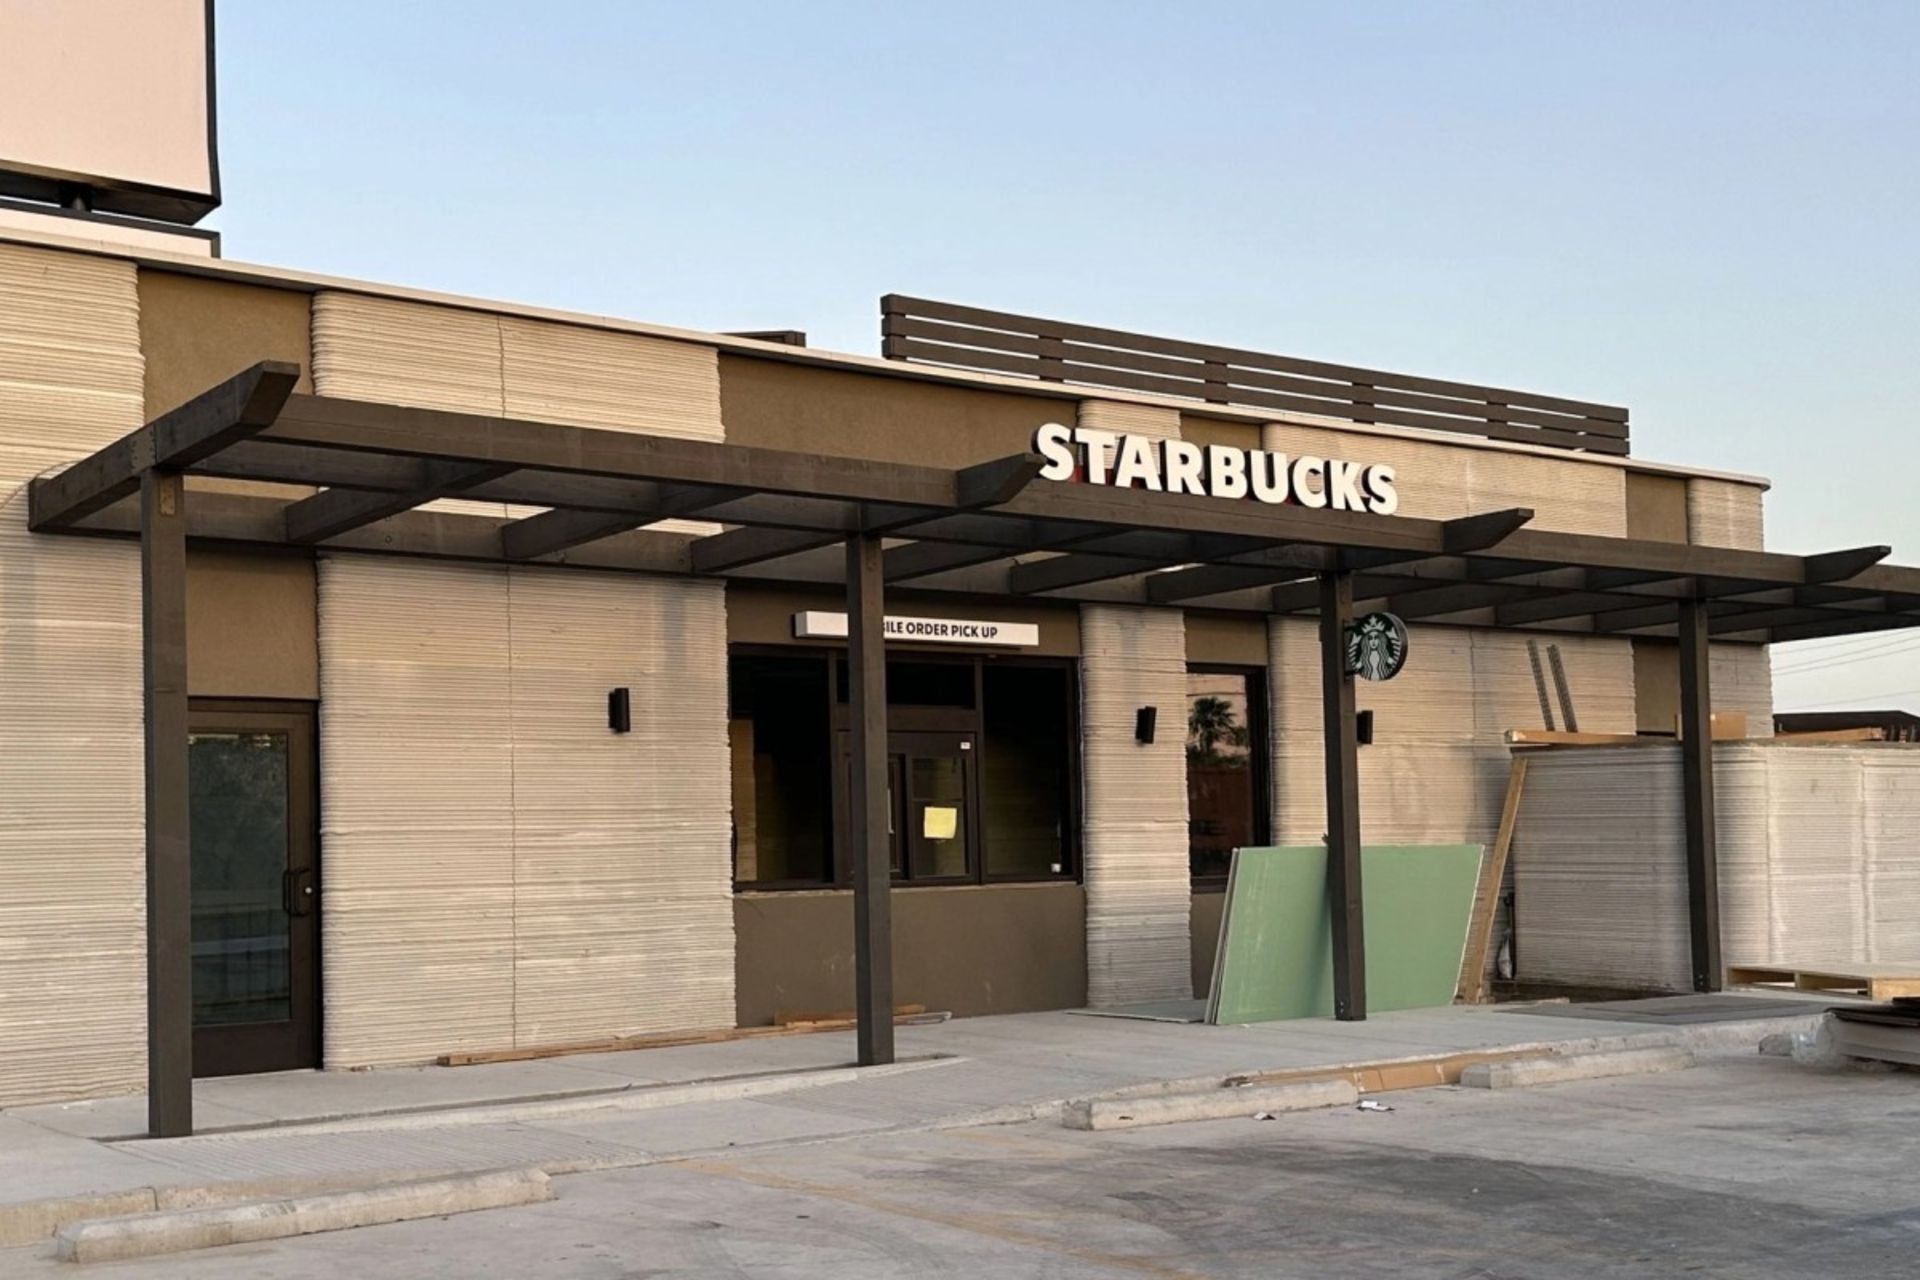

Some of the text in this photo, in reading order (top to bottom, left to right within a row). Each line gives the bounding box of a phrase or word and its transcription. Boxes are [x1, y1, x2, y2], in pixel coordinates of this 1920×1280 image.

[1035, 422, 1399, 516] STARBUCKS
[883, 621, 998, 639] ILE ORDER PICK UP
